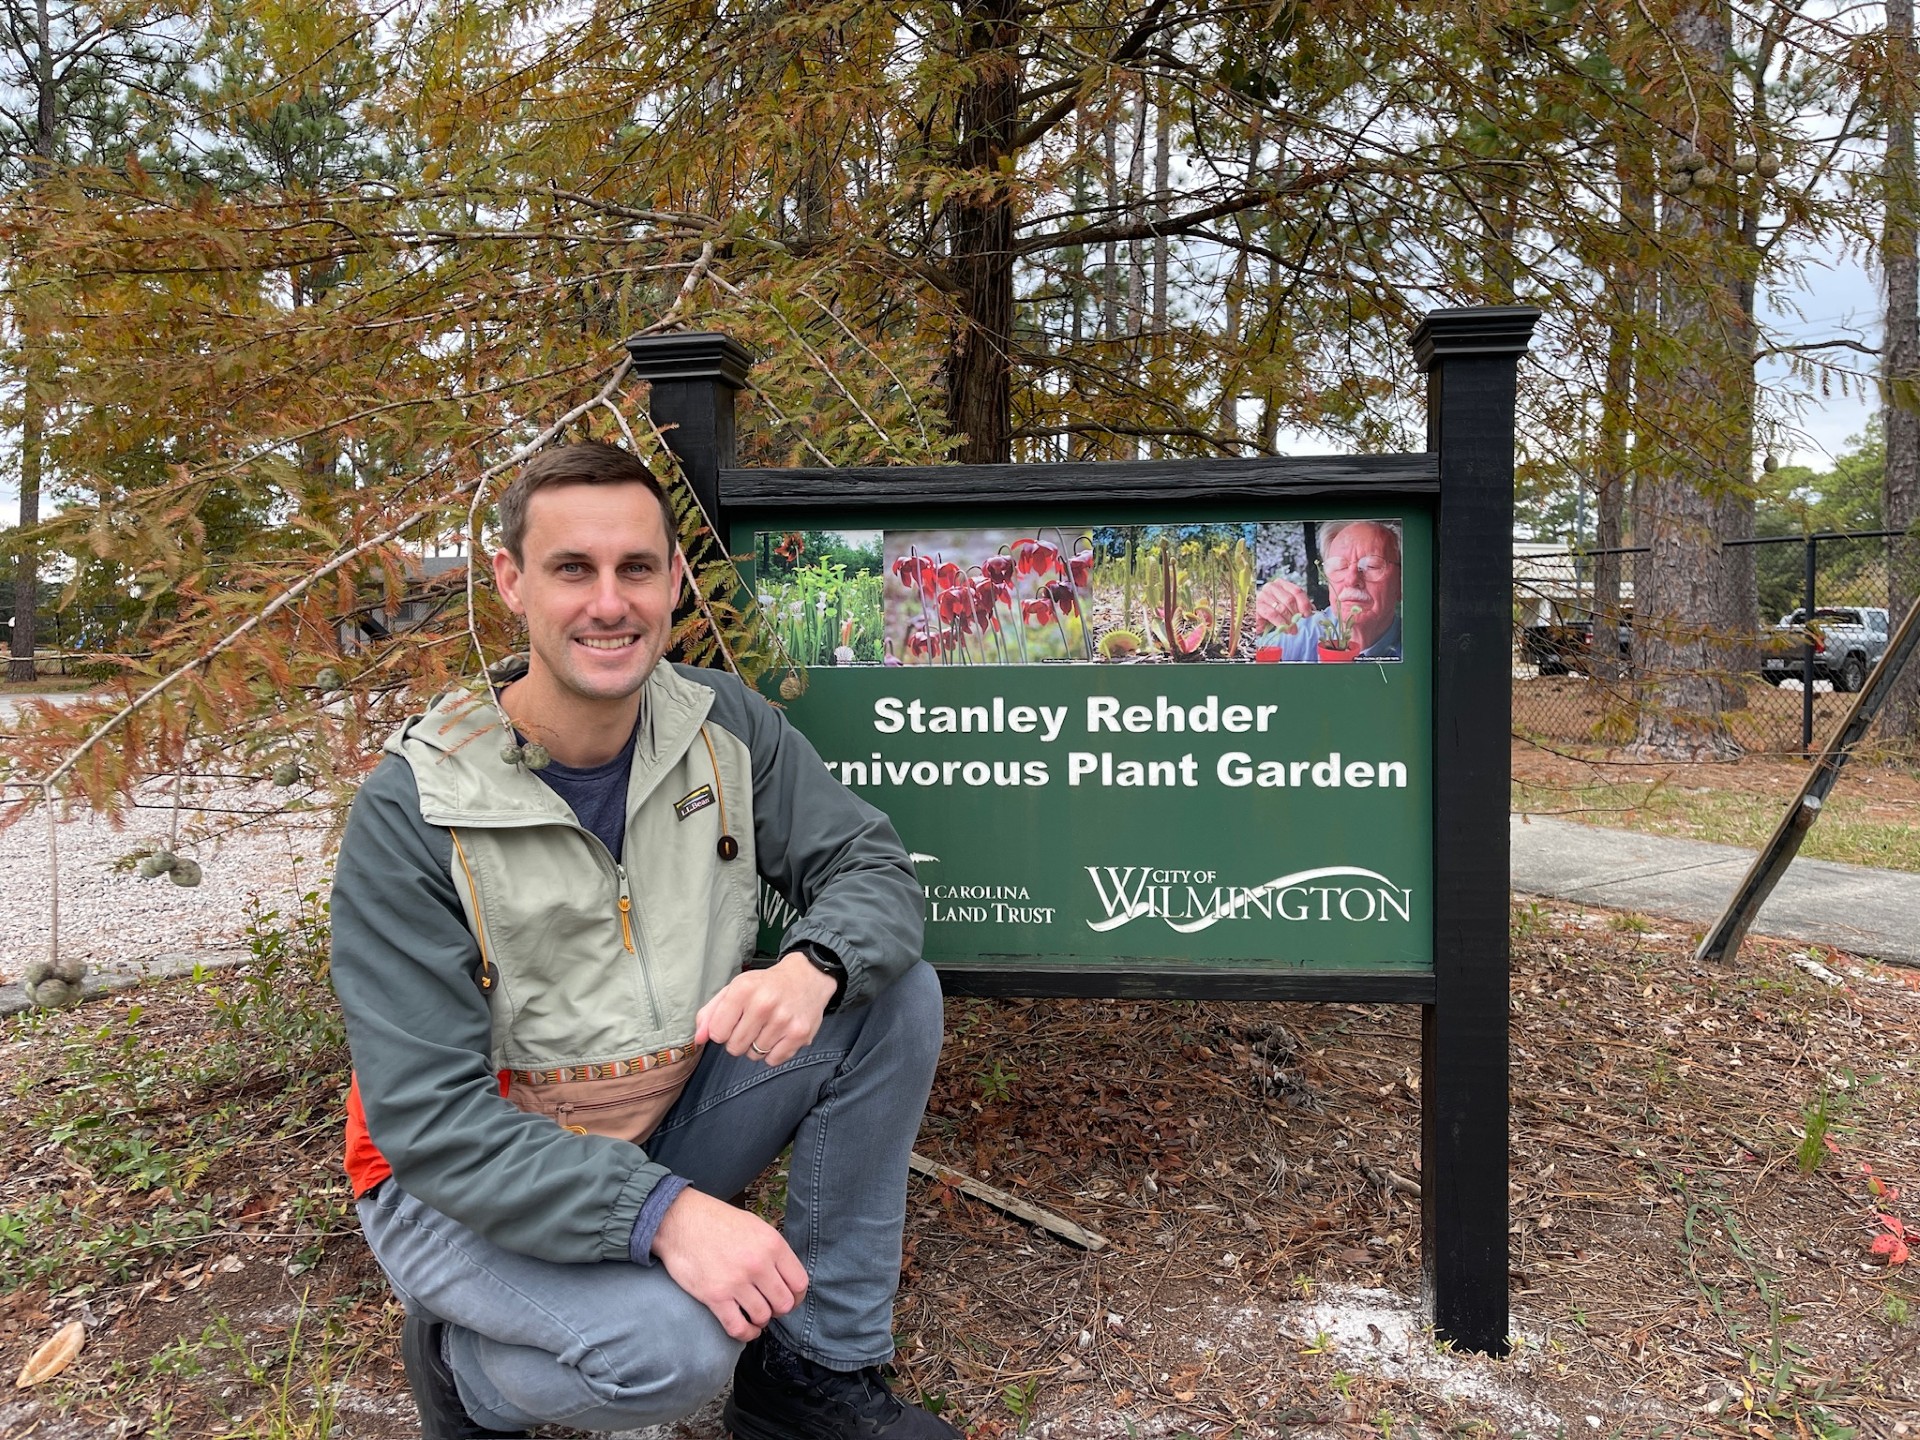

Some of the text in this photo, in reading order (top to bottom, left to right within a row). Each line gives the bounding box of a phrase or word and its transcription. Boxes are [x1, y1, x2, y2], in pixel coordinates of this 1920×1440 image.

[873, 695, 1279, 743] Stanley Rehder
[1068, 751, 1199, 787] Plant
[1216, 751, 1408, 788] Garden
[1152, 869, 1217, 884] CITY OF
[933, 885, 1031, 900] CAROLINA
[1084, 866, 1413, 923] WILMINGTON
[931, 902, 1056, 924] LAND TRUST
